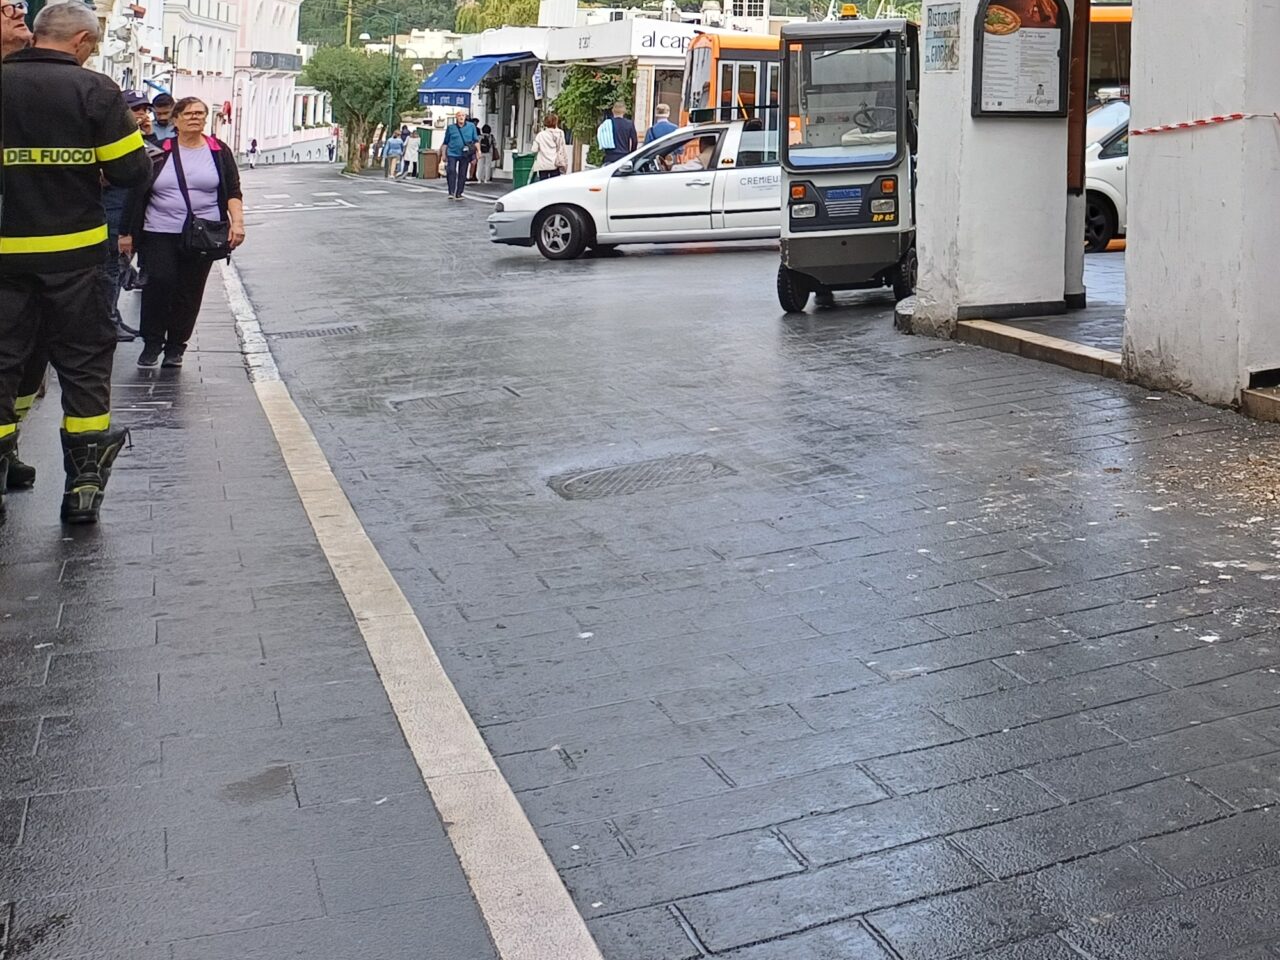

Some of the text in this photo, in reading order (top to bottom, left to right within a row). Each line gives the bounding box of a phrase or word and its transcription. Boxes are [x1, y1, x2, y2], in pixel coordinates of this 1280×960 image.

[641, 30, 656, 48] al
[6, 149, 93, 163] DEL FUOCO
[739, 175, 781, 186] CREMIEU
